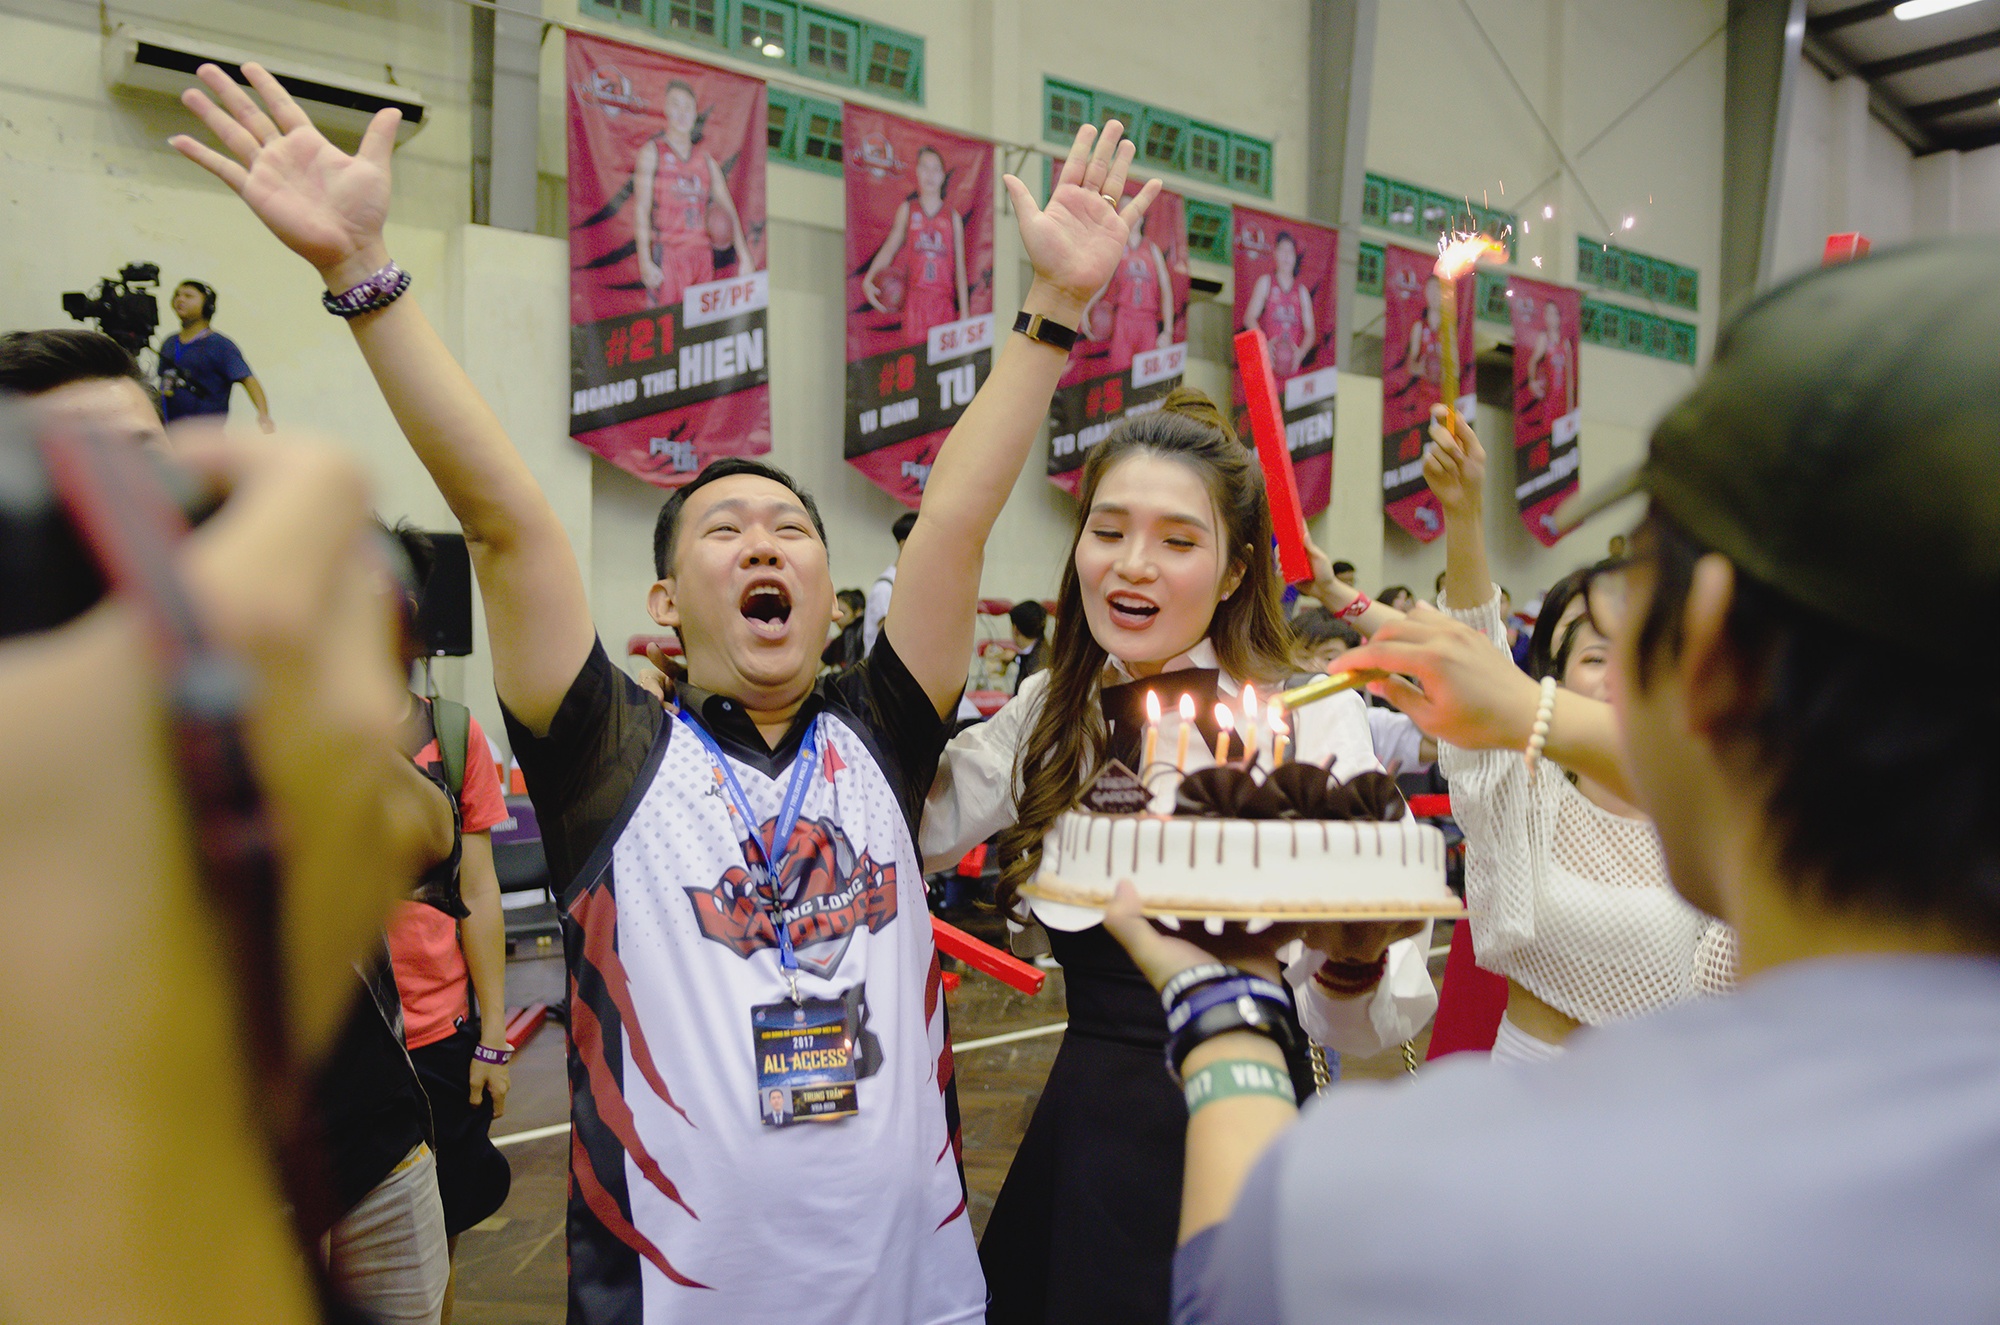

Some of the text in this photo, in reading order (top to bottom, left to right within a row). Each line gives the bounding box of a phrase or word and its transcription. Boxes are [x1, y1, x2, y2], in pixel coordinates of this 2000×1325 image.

[606, 313, 674, 367] #21
[641, 369, 677, 398] THE
[679, 328, 764, 390] HIEN
[879, 354, 916, 396] #8
[937, 364, 976, 410] TU
[817, 877, 863, 911] LONG
[763, 1048, 848, 1075] ALL ACCESS
[792, 1036, 814, 1049] 2017
